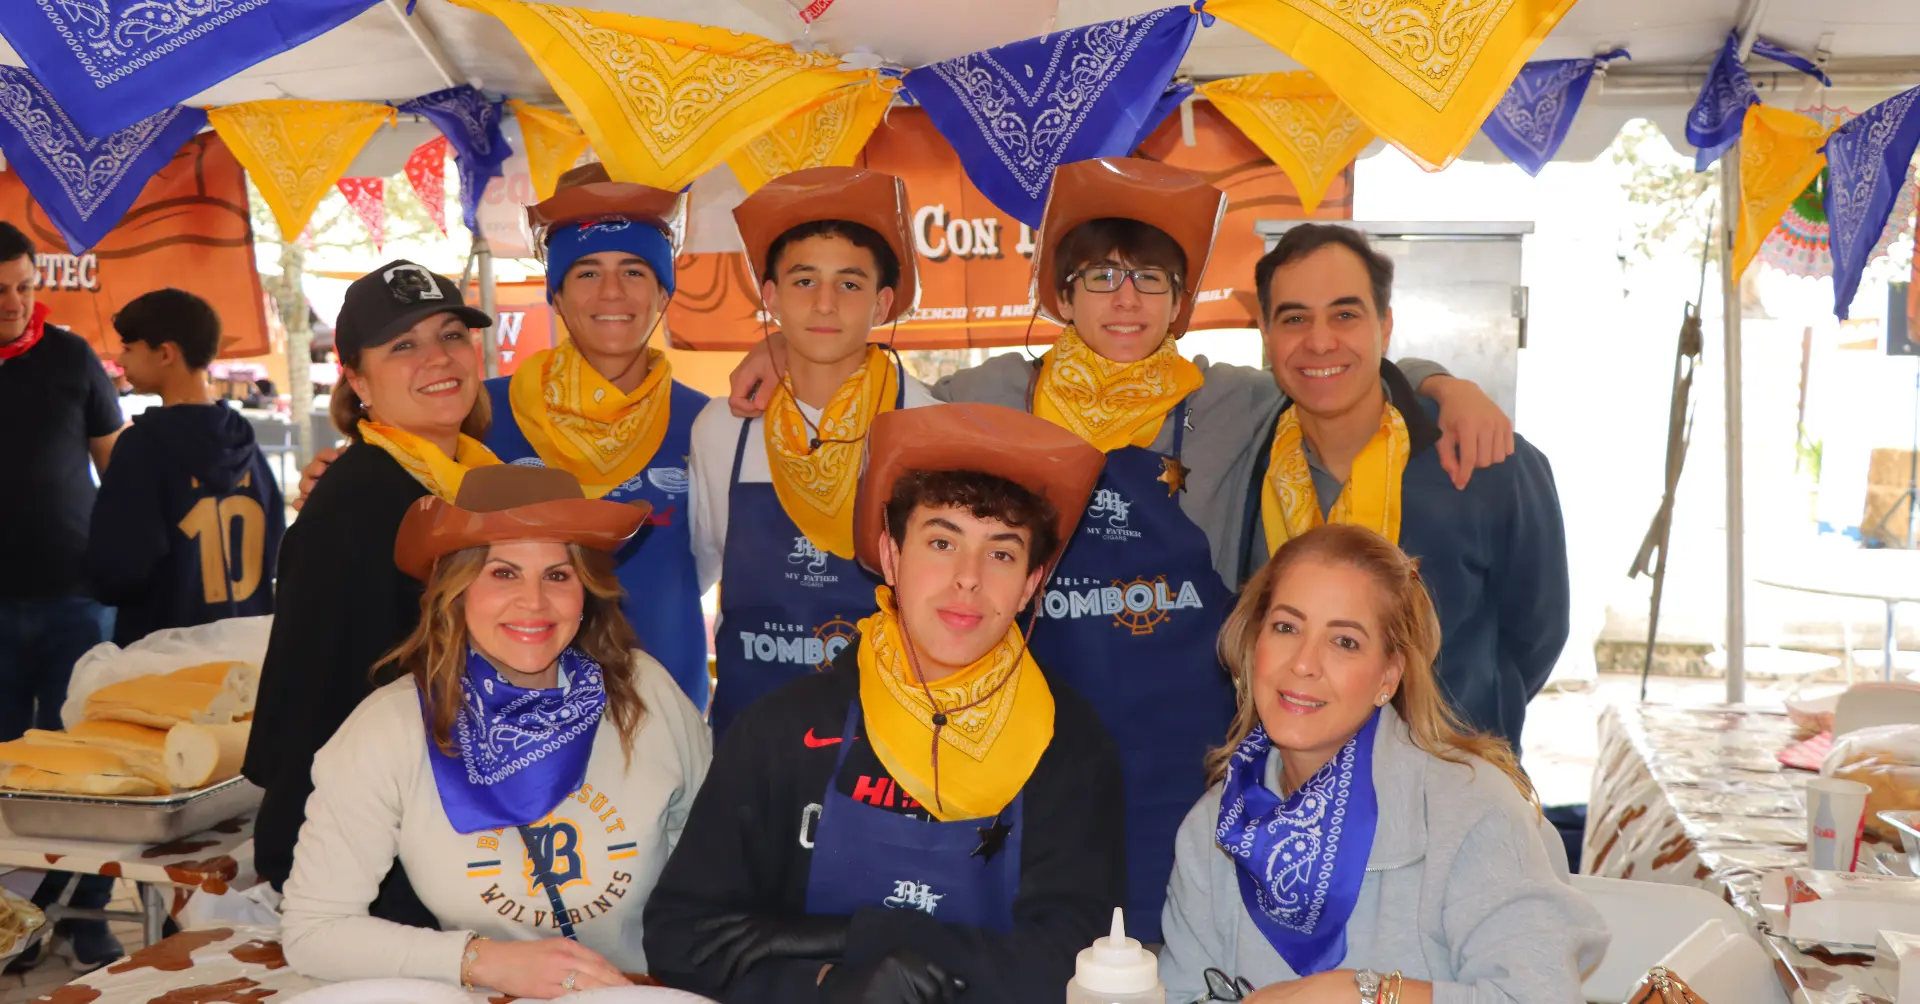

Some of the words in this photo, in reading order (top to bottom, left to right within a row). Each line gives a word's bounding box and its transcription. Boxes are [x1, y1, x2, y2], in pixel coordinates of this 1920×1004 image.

[1086, 527, 1101, 535] MY
[1105, 528, 1142, 538] FATHER
[177, 495, 266, 603] 10
[784, 572, 800, 580] MY
[803, 574, 838, 582] FATHER
[1056, 576, 1101, 586] BELEN
[800, 580, 824, 588] CIGARS
[764, 621, 804, 632] BELEN
